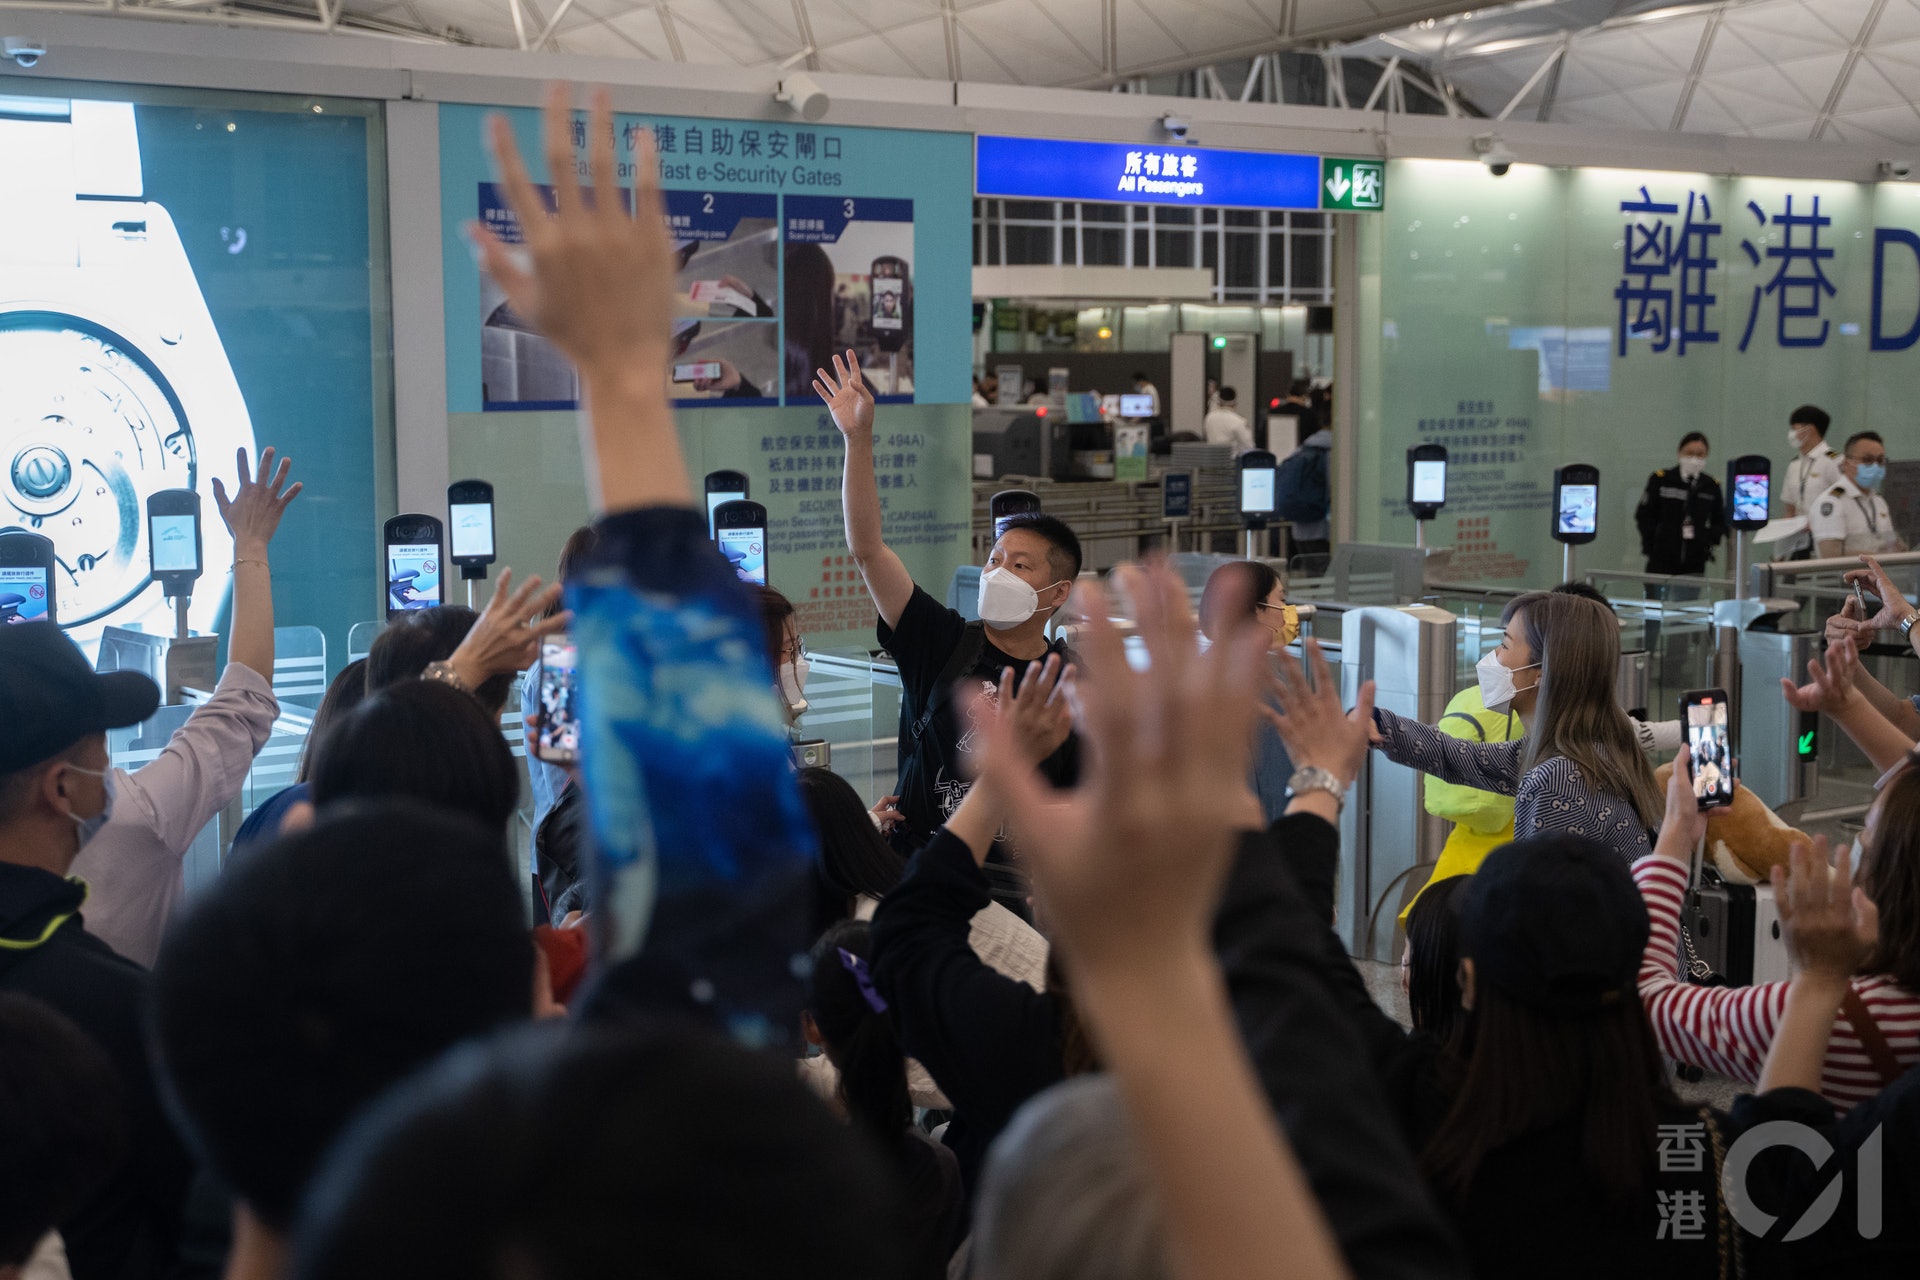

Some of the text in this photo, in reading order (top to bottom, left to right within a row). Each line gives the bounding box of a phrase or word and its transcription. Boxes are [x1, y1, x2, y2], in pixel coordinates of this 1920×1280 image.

[696, 161, 787, 187] e-Security
[792, 165, 842, 187] Gates
[1124, 151, 1197, 178] 所有旅客
[1118, 175, 1204, 198] All Passengers
[703, 193, 714, 214] 2
[844, 199, 855, 219] 3
[1613, 186, 1837, 357] 離港
